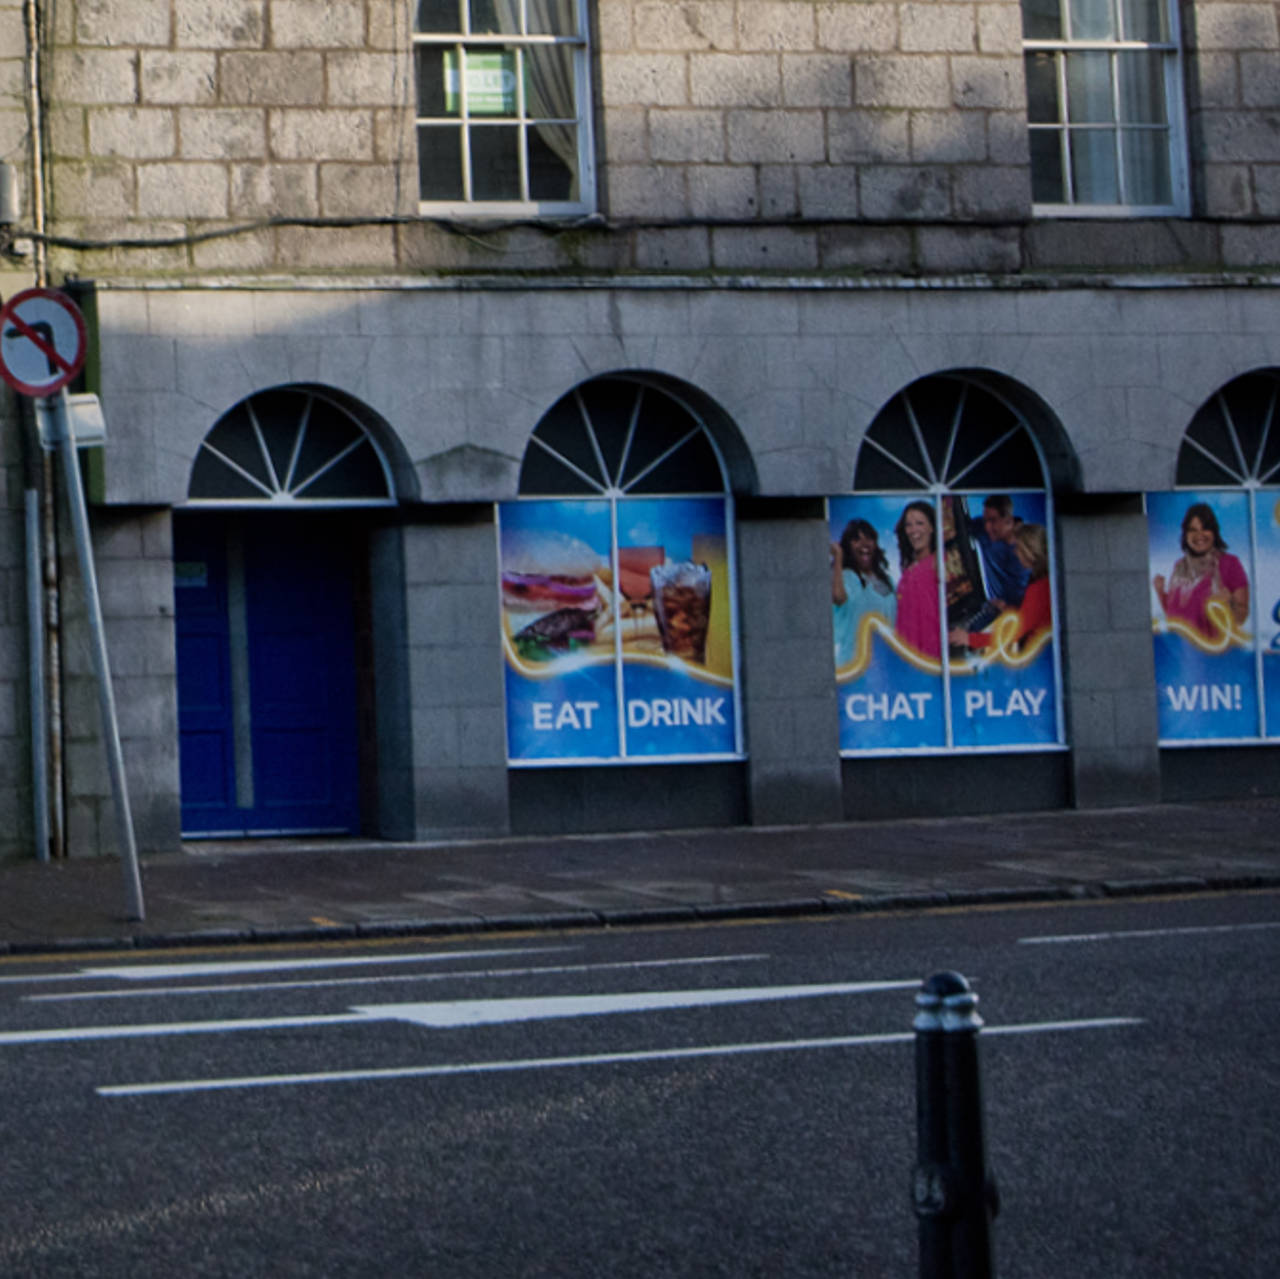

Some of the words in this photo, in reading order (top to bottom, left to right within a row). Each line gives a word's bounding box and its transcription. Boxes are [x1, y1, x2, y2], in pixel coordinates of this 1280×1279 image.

[532, 700, 600, 731] EAT
[627, 697, 727, 728] DRINK
[844, 692, 933, 722] CHAT
[964, 688, 1047, 718] PLAY
[1166, 684, 1242, 712] WIN!
